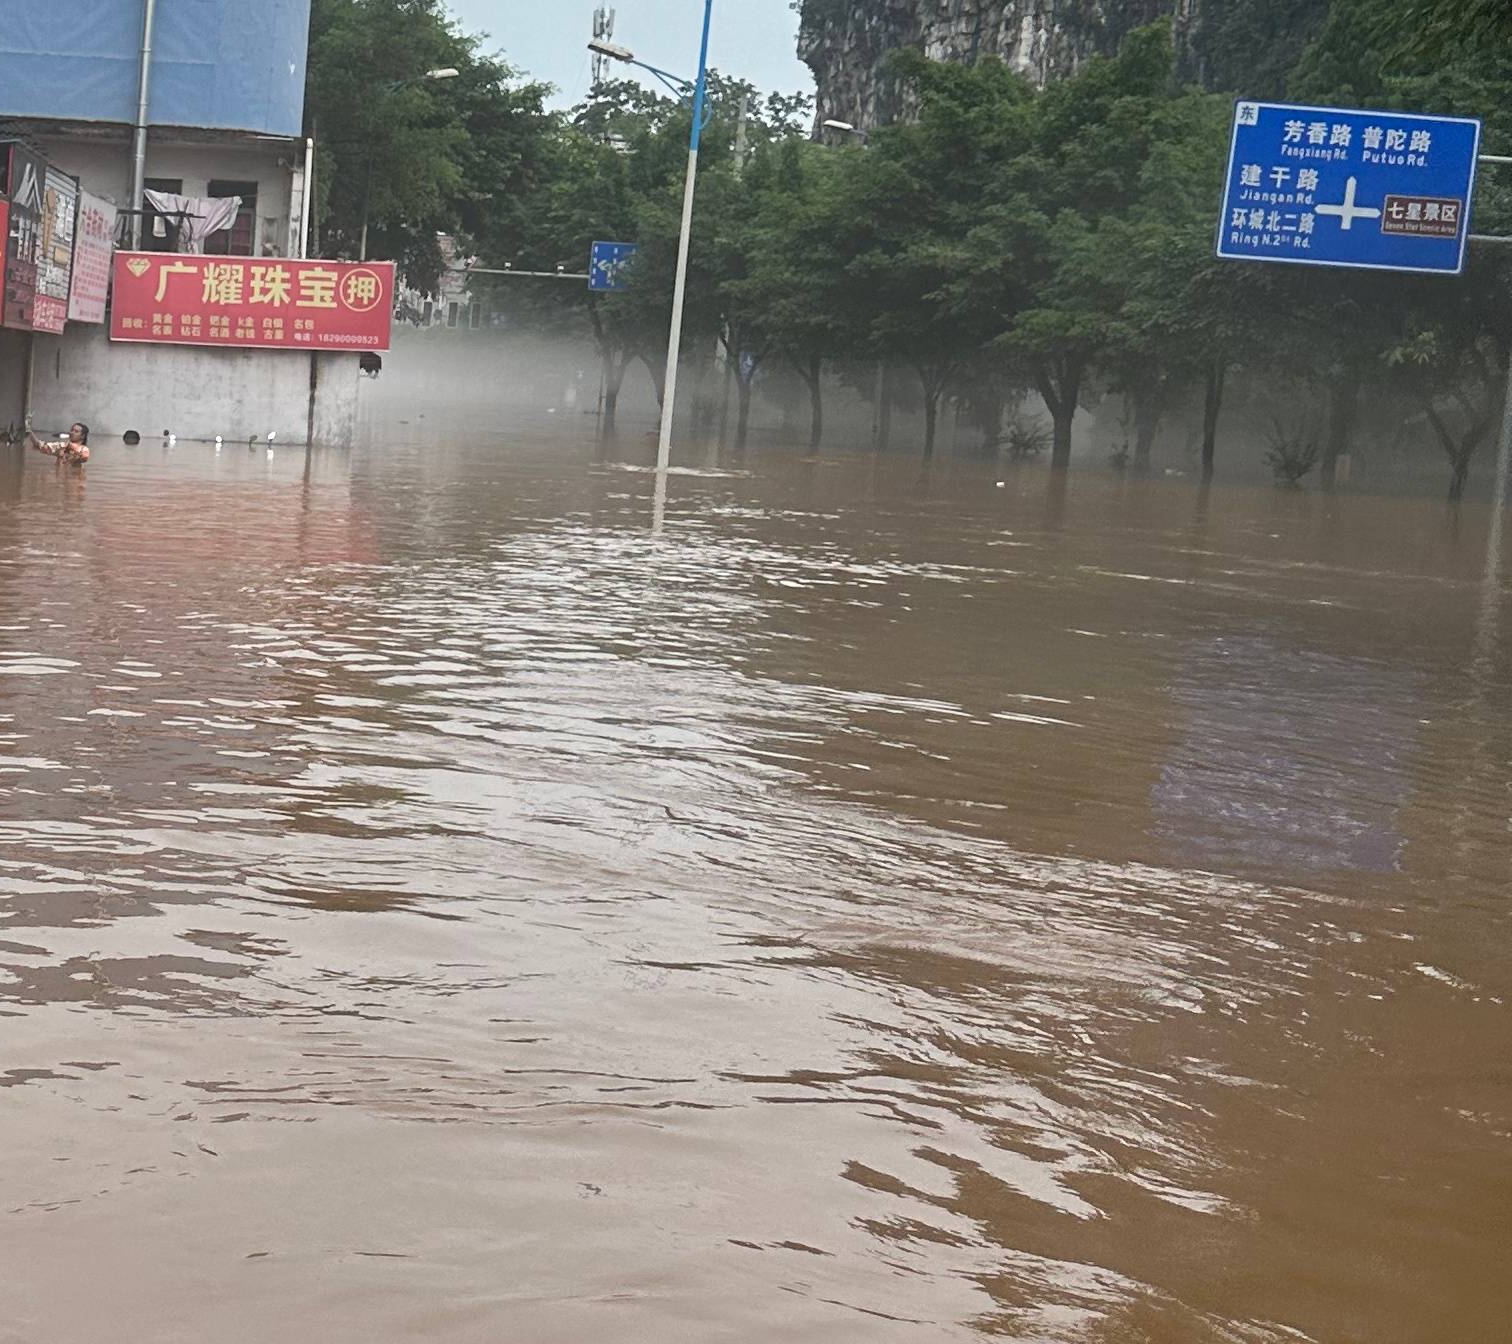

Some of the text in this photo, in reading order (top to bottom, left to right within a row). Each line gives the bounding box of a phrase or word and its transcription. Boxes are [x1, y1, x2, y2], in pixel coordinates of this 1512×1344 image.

[1240, 106, 1255, 120] 东
[1283, 119, 1432, 153] 芳香路 普陀路
[1362, 151, 1405, 164] Putuo
[1240, 164, 1320, 192] 建干路
[1240, 189, 1293, 205] Jiangan
[1231, 207, 1315, 234] 环城北二路
[1388, 202, 1457, 222] 七星景区
[1231, 232, 1259, 248] Ring
[154, 260, 339, 309] 广耀珠宝
[346, 275, 377, 306] 押
